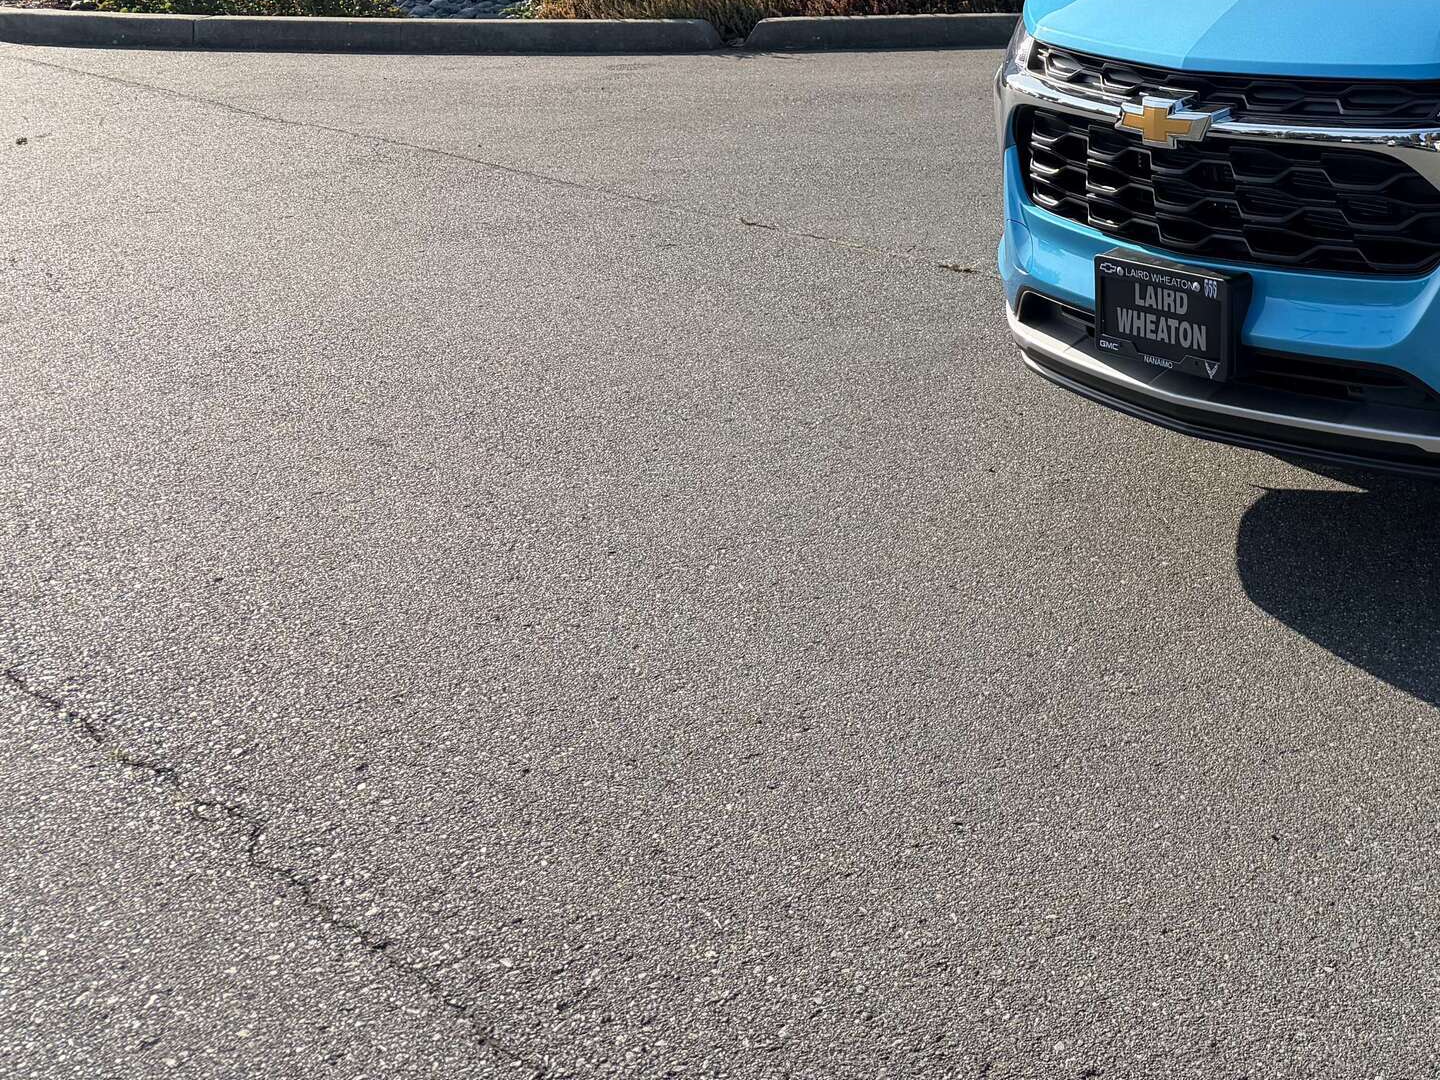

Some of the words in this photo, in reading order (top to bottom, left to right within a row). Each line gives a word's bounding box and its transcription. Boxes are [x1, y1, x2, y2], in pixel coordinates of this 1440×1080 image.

[1124, 267, 1150, 281] LAIRD
[1150, 273, 1195, 291] WHEATON
[1134, 282, 1189, 316] LAIRD
[1116, 306, 1208, 352] WHEATON
[1099, 339, 1120, 351] GMC
[1143, 354, 1174, 369] NANAIMO
